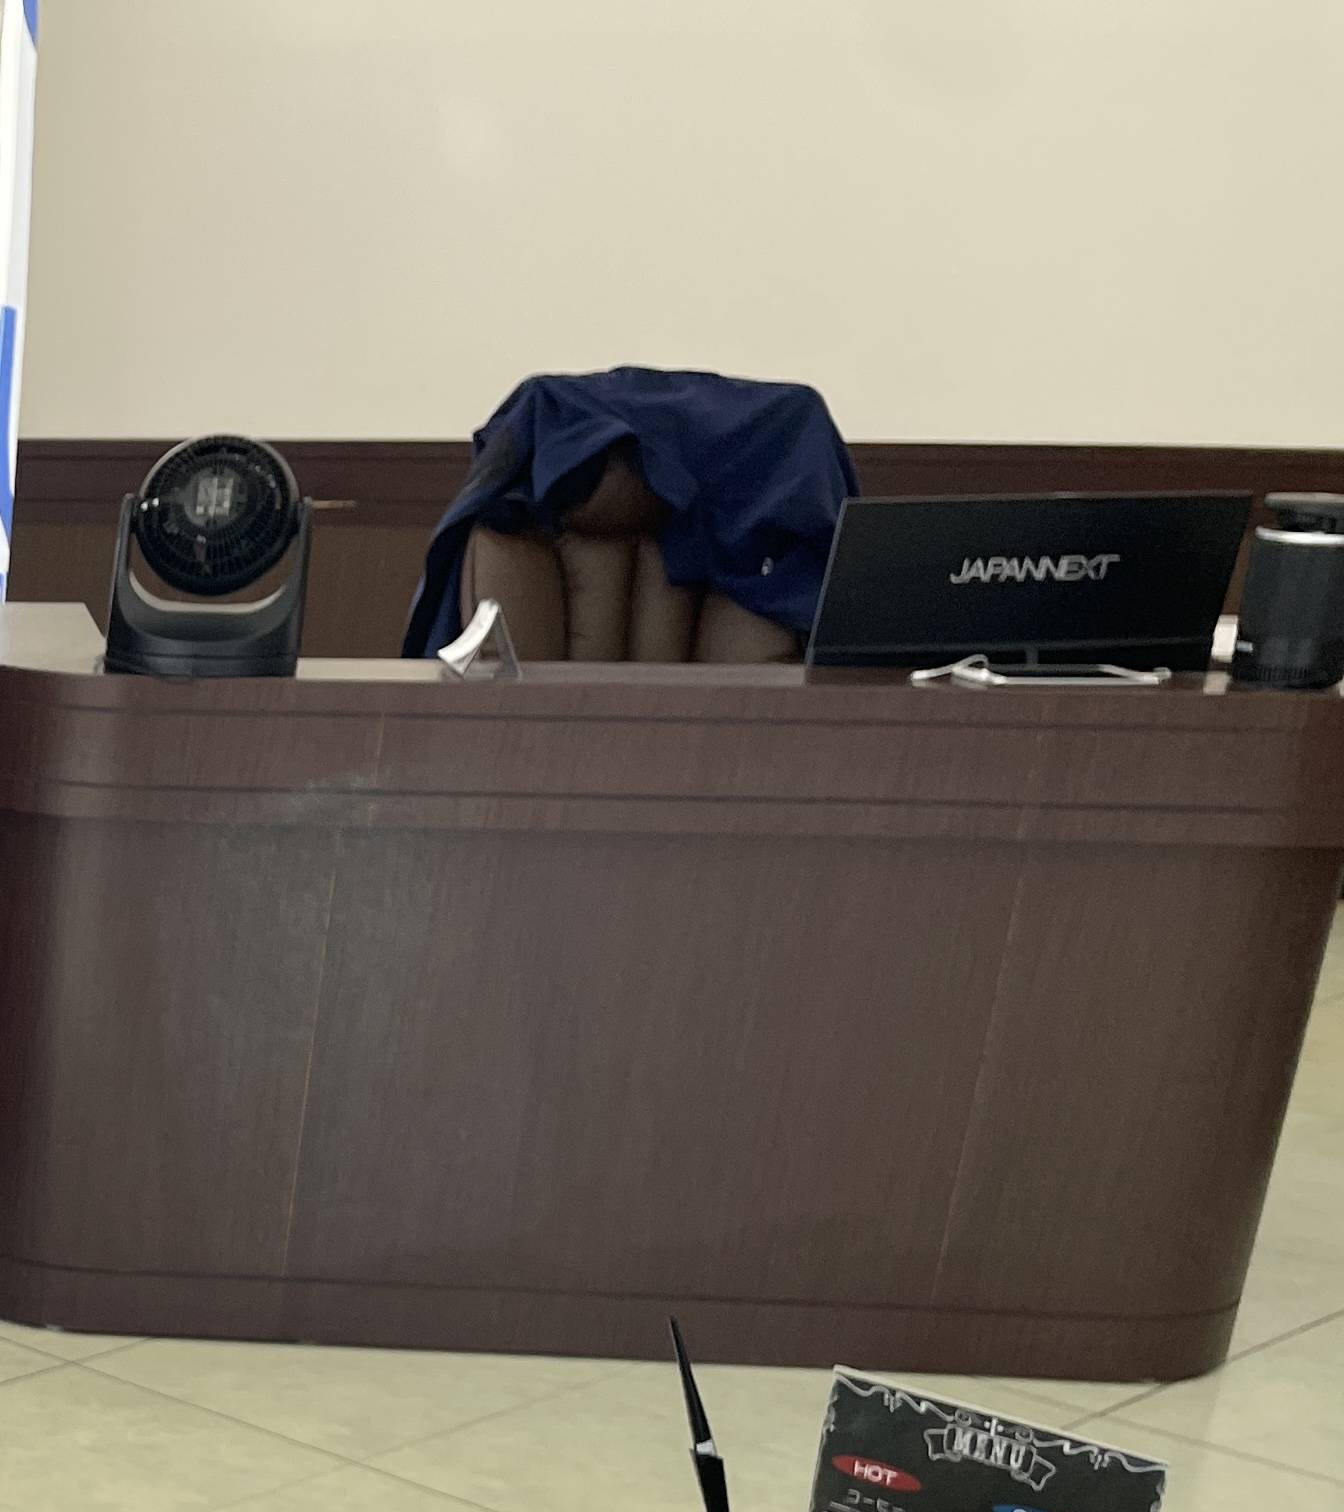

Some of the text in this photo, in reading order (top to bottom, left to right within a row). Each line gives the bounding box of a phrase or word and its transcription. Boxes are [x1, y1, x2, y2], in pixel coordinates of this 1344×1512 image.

[950, 553, 1120, 584] JAPANNEXT
[953, 1427, 1028, 1469] MENU
[854, 1463, 898, 1485] HOT
